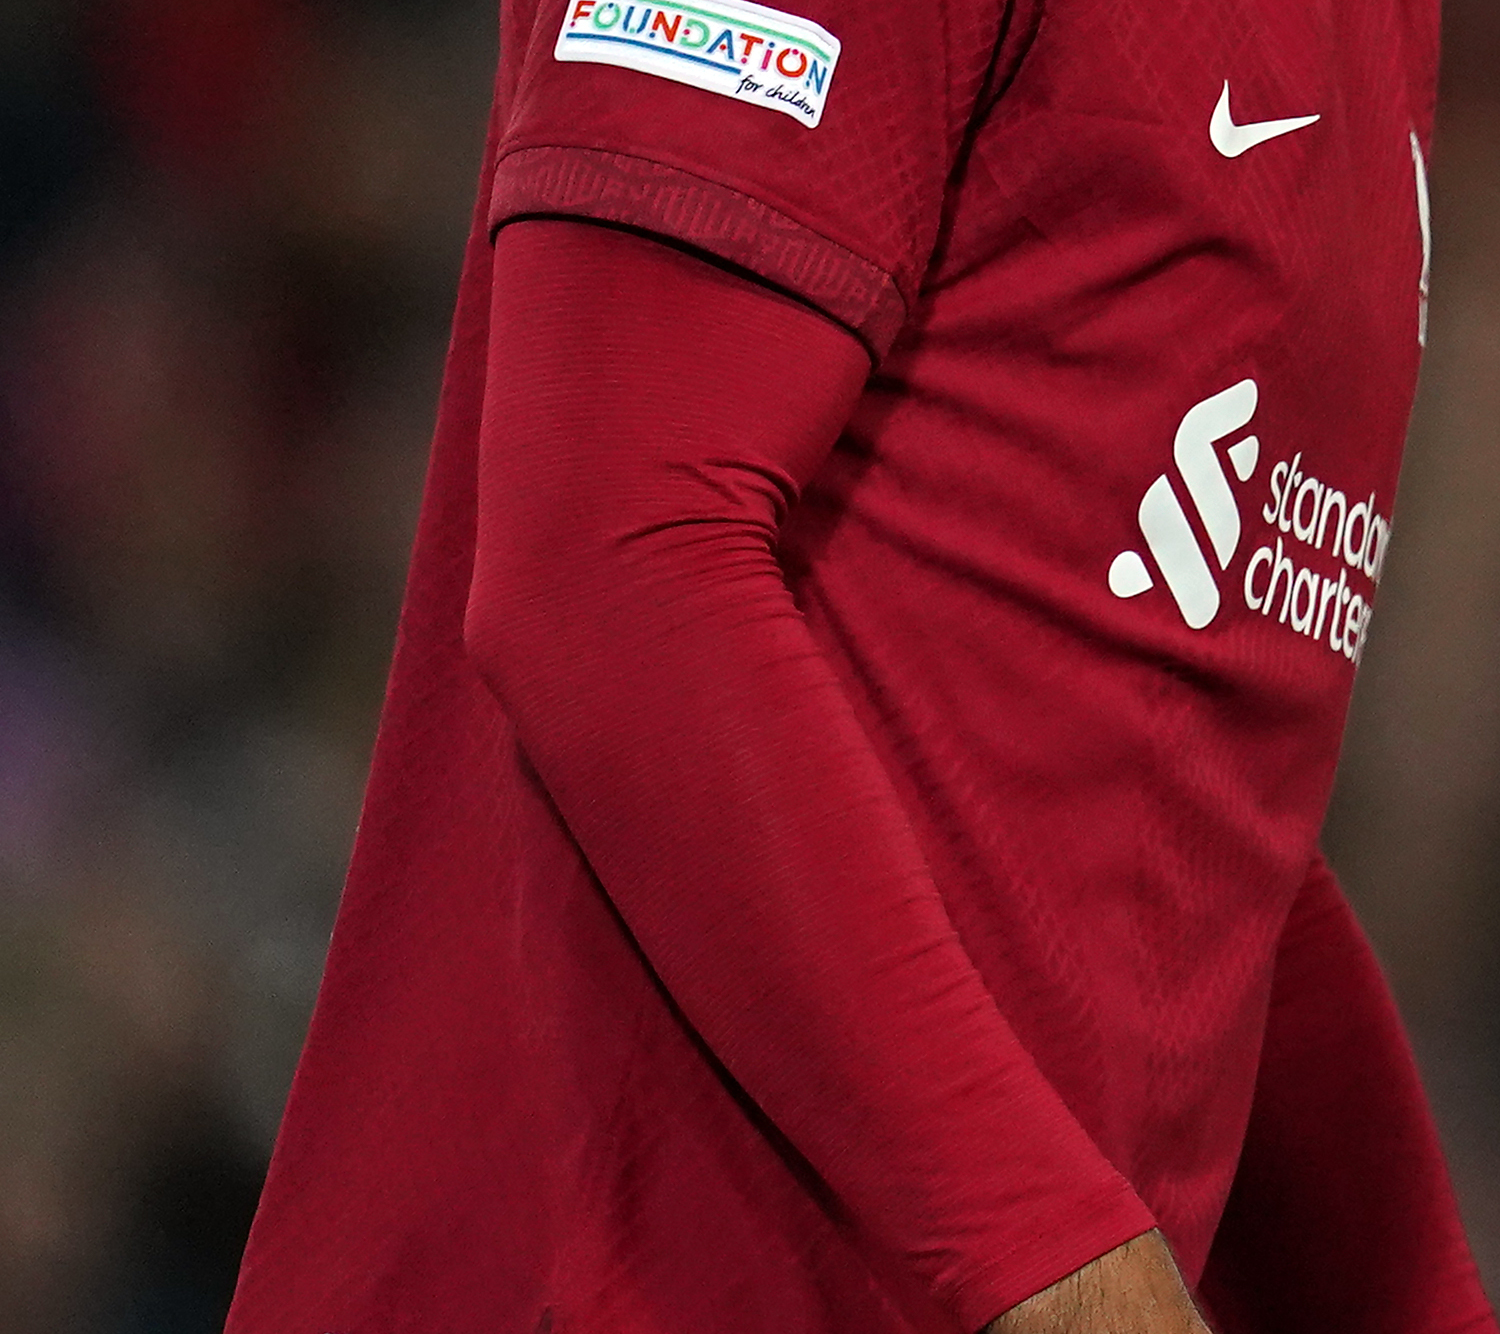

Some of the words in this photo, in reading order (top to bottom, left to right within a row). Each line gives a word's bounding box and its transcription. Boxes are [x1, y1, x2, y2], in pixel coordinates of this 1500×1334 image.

[569, 0, 828, 96] FOUNDATION
[735, 74, 762, 95] for
[765, 86, 816, 119] children
